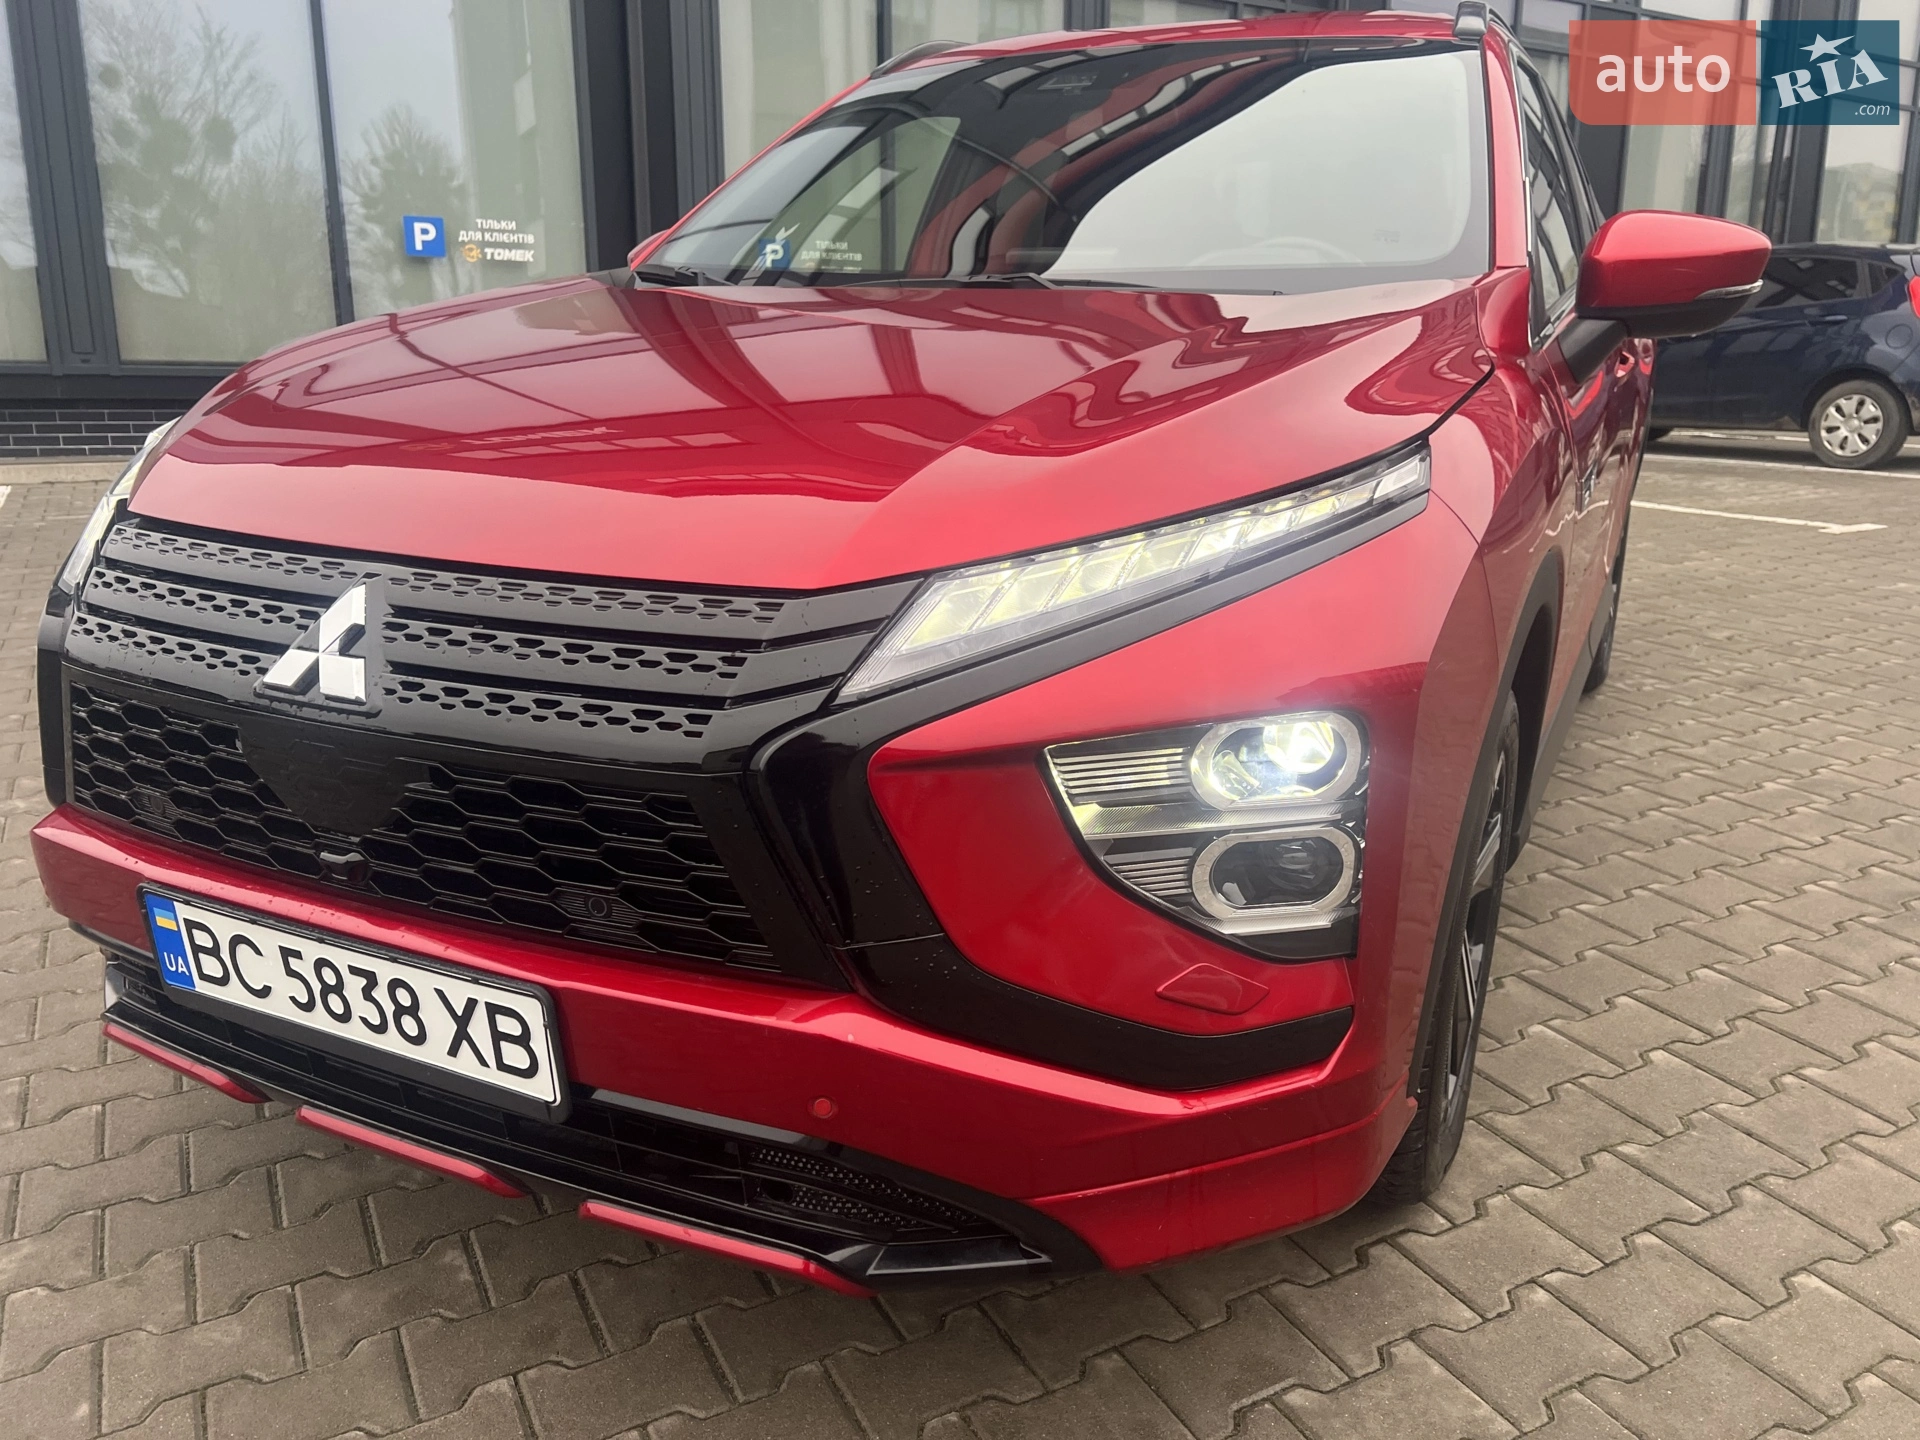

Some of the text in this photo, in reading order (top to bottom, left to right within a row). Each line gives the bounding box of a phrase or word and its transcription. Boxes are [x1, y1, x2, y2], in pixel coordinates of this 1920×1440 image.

[475, 218, 516, 230] ТІЛЬКИ
[413, 222, 437, 251] P
[458, 230, 535, 244] ДЛЯ КЛІЄНТІВ
[484, 247, 535, 262] TOMEK
[164, 951, 189, 977] UA
[183, 917, 539, 1079] BC 5838 XB
